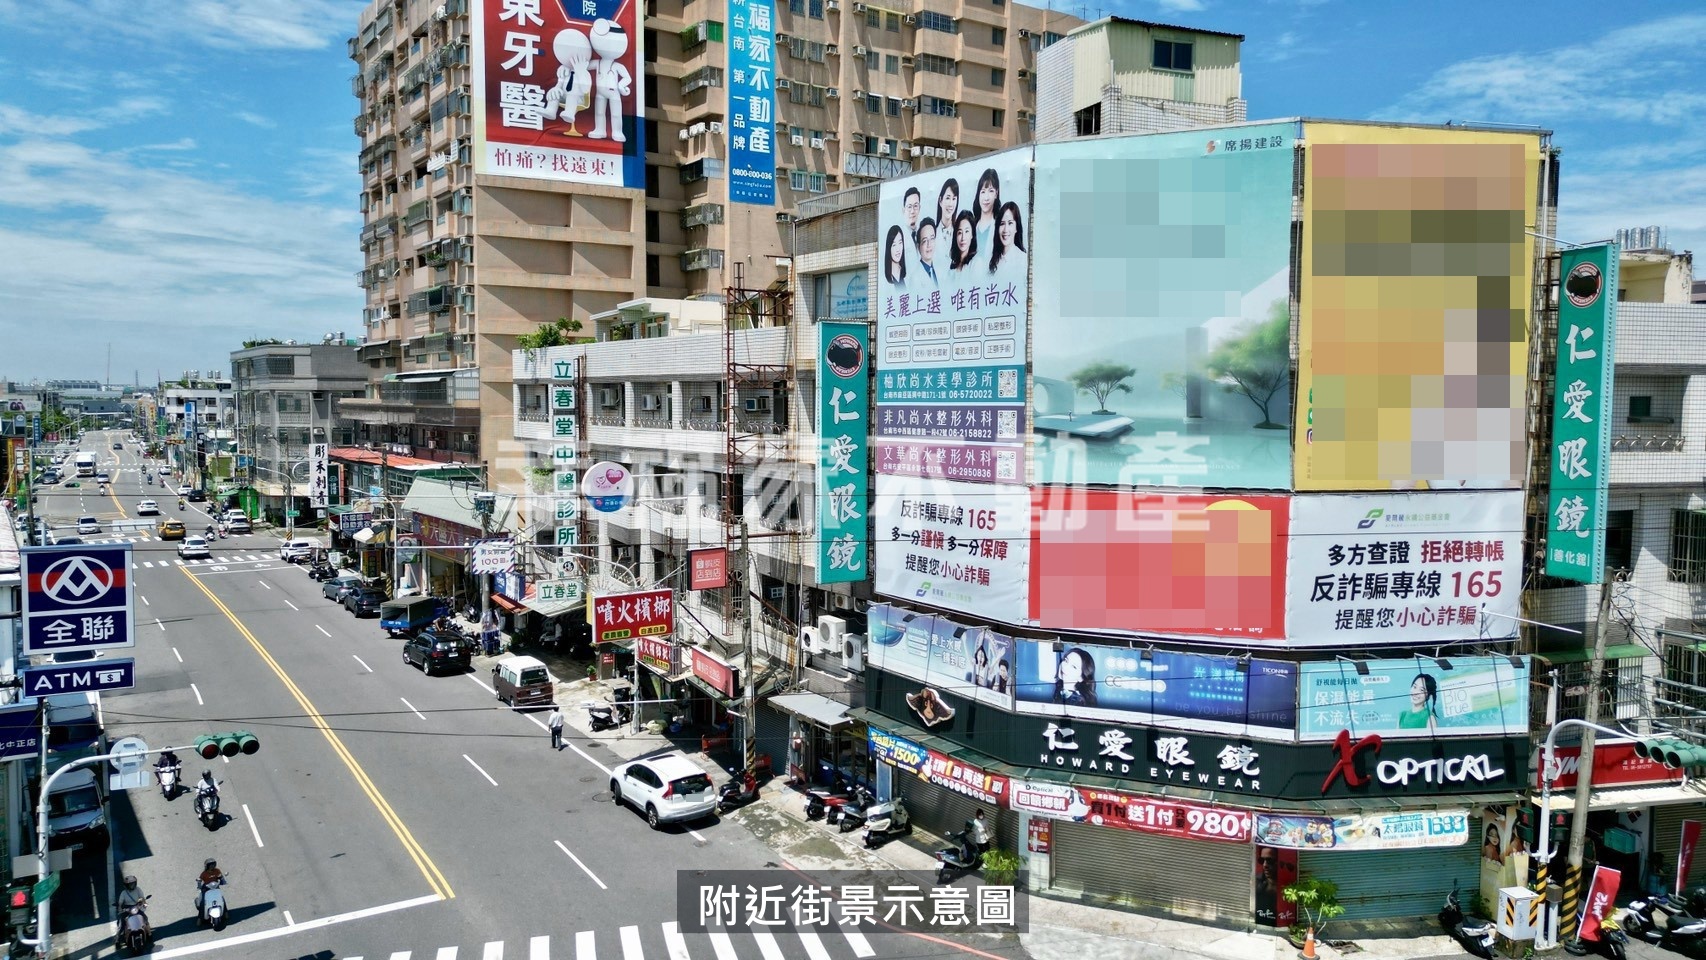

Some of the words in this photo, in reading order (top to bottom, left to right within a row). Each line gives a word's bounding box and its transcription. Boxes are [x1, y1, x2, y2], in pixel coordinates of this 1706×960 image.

[749, 3, 771, 154] 福家不動產
[733, 69, 746, 151] 第一品牌
[884, 290, 941, 318] 美麗上選
[950, 282, 1019, 312] 唯有尚水
[949, 390, 993, 399] 06-5720022
[883, 409, 992, 427] 非凡尚水整形外科
[1554, 324, 1597, 538] 仁愛眼鏡
[949, 429, 992, 438] 06-2158822
[554, 361, 576, 545] 立春堂中醫診所
[883, 445, 991, 467] 文華尚水整形外科
[827, 386, 862, 571] 仁愛眼鏡
[948, 466, 991, 478] 06-2950836
[900, 500, 964, 526] 反詐騙專線
[968, 508, 996, 531] 165
[892, 526, 944, 550] 多一分謹慎
[948, 536, 1008, 561] 多一分保障
[1328, 541, 1410, 566] 多方查證
[1421, 540, 1504, 564] 拒絕轉帳
[905, 553, 990, 586] 提醒您小心詐騙
[542, 583, 577, 599] 立春堂
[1310, 570, 1442, 602] 反詐騙專線
[1451, 570, 1502, 598] 165
[597, 595, 671, 625] 噴火檳榔
[1335, 605, 1477, 630] 提醒您小心詐騙
[43, 615, 114, 644] 全聯
[34, 671, 91, 690] ATM
[1445, 703, 1469, 716] true
[1043, 722, 1261, 776] 仁愛眼鏡
[1041, 754, 1130, 773] HOWARD
[1150, 767, 1261, 791] EYEWEAR
[1376, 754, 1505, 786] OPTICAL
[1186, 809, 1240, 837] 980
